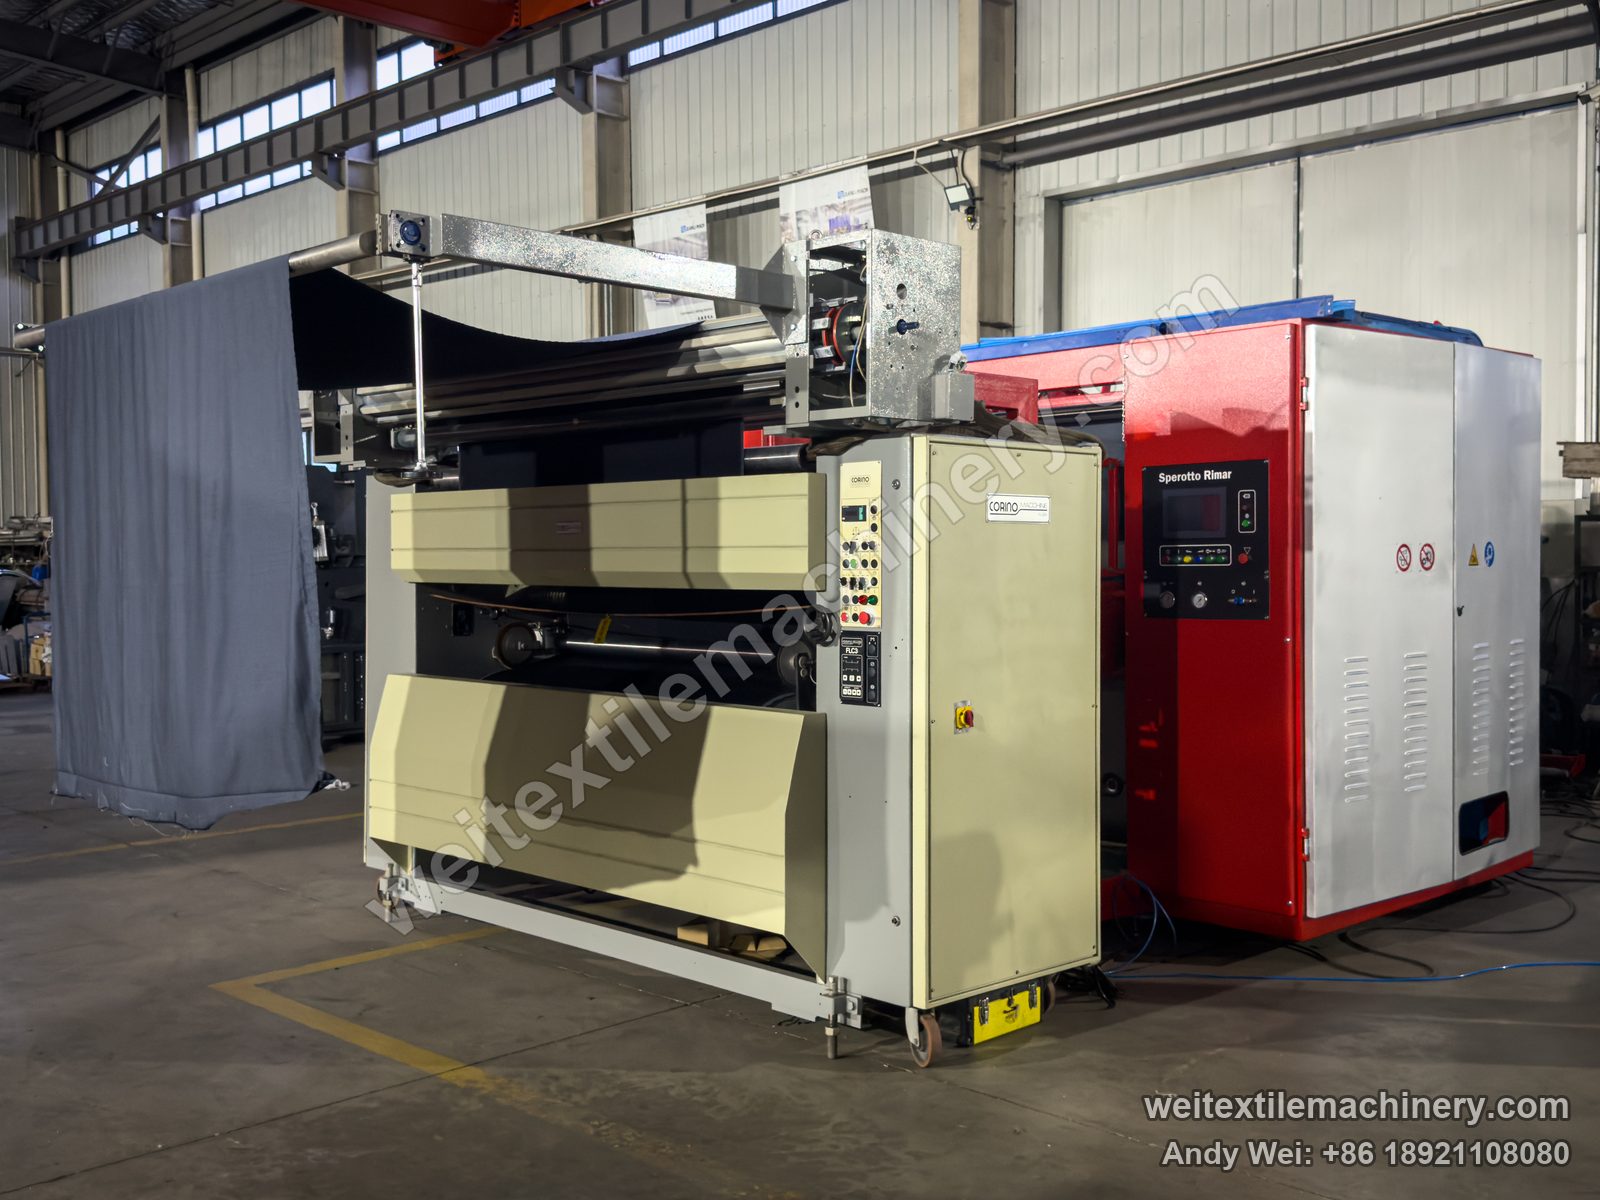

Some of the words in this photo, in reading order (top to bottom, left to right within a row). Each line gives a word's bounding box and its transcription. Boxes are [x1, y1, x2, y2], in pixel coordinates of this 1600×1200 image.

[1158, 471, 1201, 485] Sperotto
[1203, 469, 1232, 481] Rimar
[989, 501, 1019, 513] CORINO
